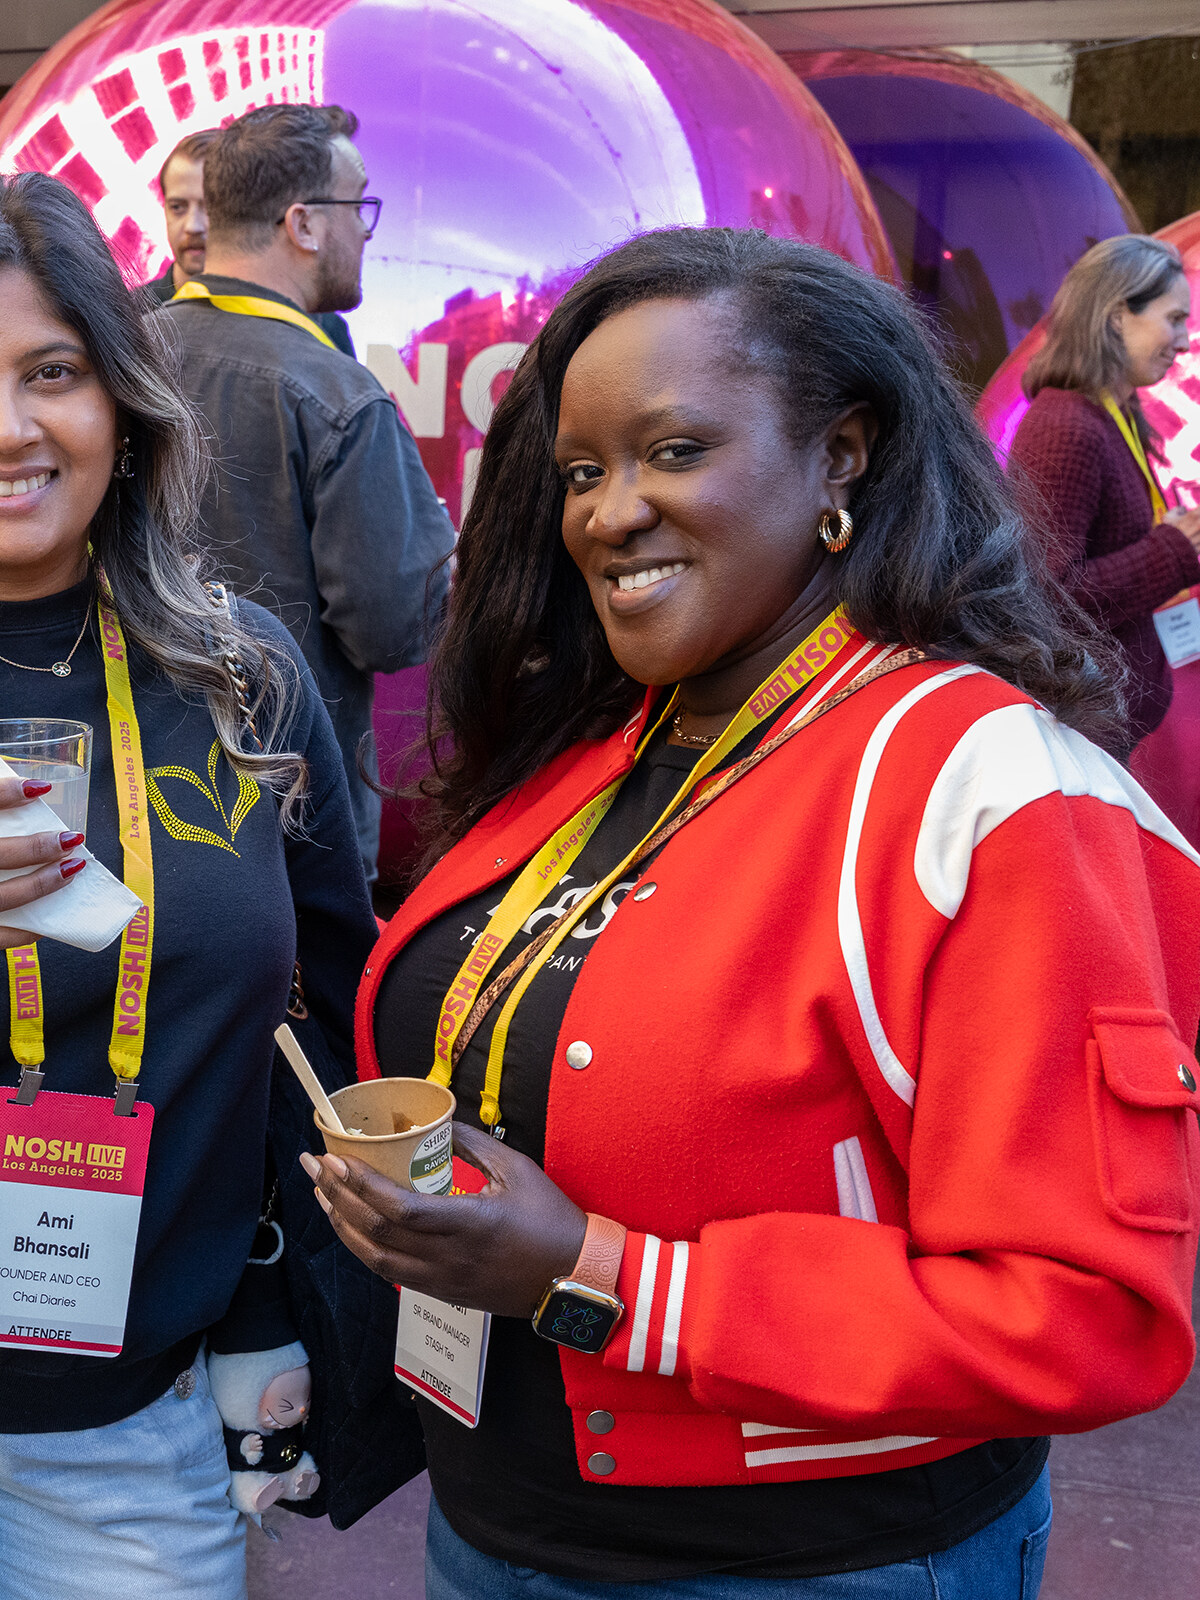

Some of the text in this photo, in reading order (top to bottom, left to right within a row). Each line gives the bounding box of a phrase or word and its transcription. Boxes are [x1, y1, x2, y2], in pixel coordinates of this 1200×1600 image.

[750, 678, 790, 717] LIVE
[119, 721, 140, 839] Los Angeles 2025
[537, 858, 558, 880] Los
[555, 810, 596, 860] Angeles
[469, 935, 502, 974] LIVE
[16, 976, 39, 1020] LIVE
[2, 1158, 123, 1181] Los Angeles 2025
[88, 1145, 126, 1167] LIVE
[37, 1211, 74, 1230] Ami
[13, 1236, 90, 1260] Bhansali
[49, 1273, 74, 1285] AND
[76, 1275, 101, 1288] CEO
[12, 1291, 76, 1308] Chai Diaries
[7, 1325, 72, 1341] ATTENDEE
[422, 1309, 442, 1329] BRAND
[443, 1322, 471, 1348] MANAGER
[424, 1334, 455, 1362] STASH Tea
[420, 1369, 452, 1398] ATTENDEE
